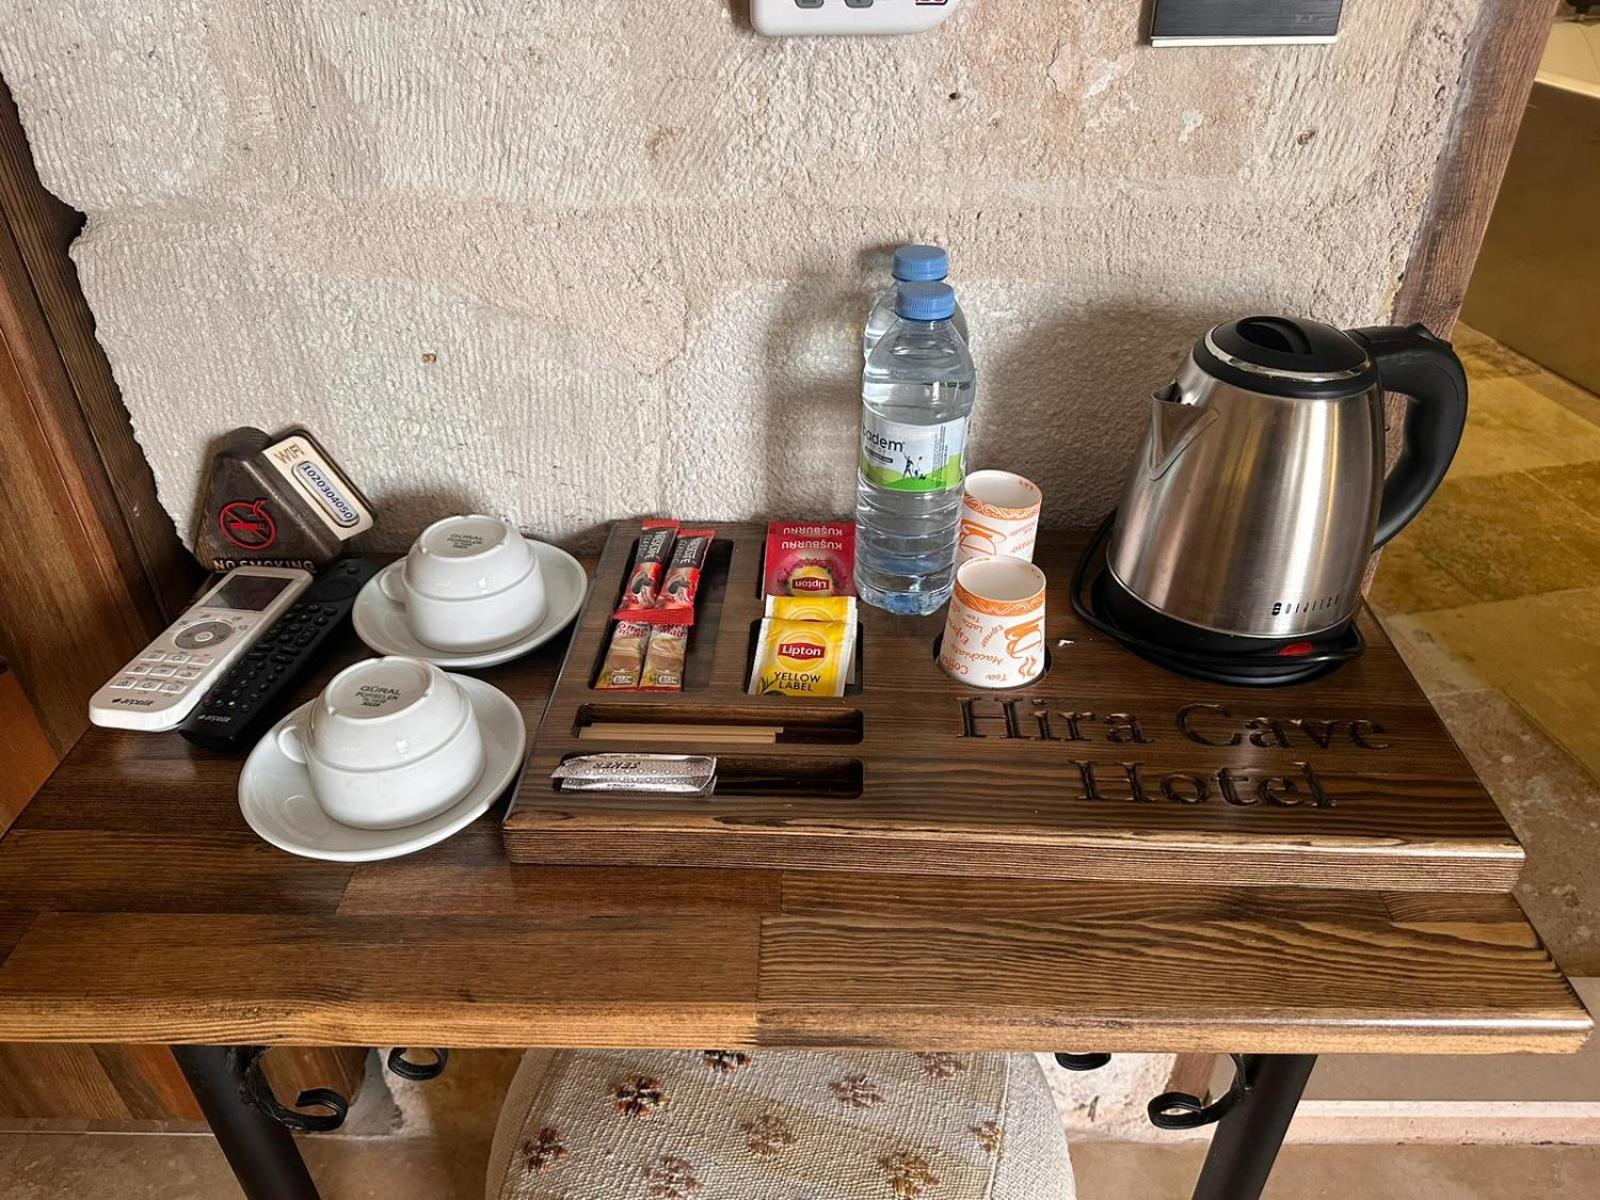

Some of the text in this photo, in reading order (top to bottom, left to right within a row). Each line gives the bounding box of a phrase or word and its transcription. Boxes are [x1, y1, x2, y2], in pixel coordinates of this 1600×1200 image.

[302, 464, 353, 519] 1020304050
[781, 539, 843, 551] KUŞBURNU
[213, 559, 235, 570] NO
[795, 580, 827, 591] Lipton
[782, 644, 821, 659] Lipton
[774, 671, 821, 683] YELLOW
[778, 681, 813, 692] LABEL
[955, 696, 1394, 750] Hira Cave
[1068, 759, 1337, 809] Hotel
